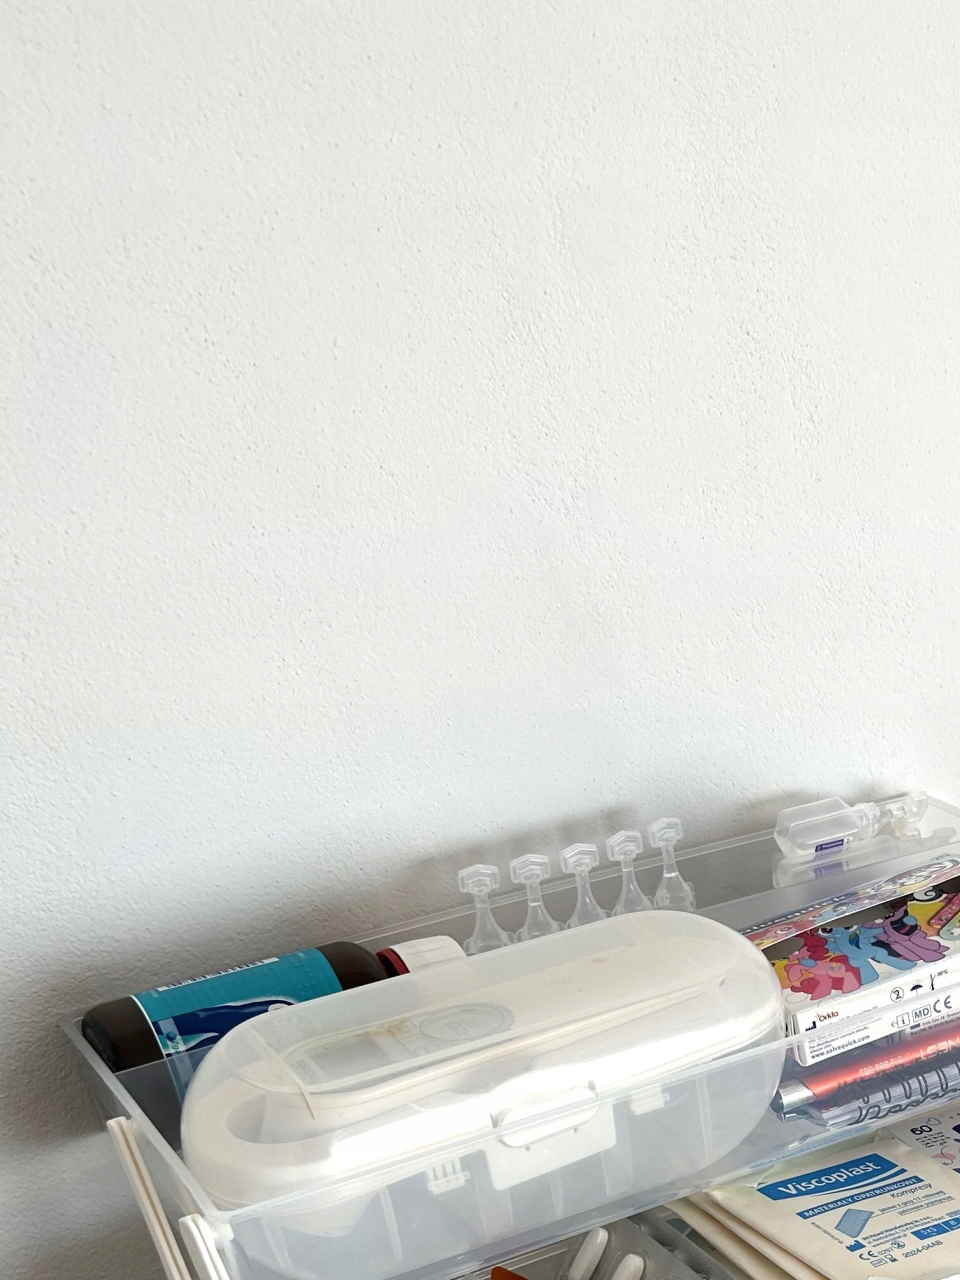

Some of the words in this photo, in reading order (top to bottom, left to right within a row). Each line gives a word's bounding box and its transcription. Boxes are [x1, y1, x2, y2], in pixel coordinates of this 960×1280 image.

[819, 1011, 839, 1022] Orkla
[778, 1161, 881, 1195] Viscoplast
[853, 1177, 918, 1201] OPATRUNKOWE
[890, 1182, 932, 1199] Kompresy
